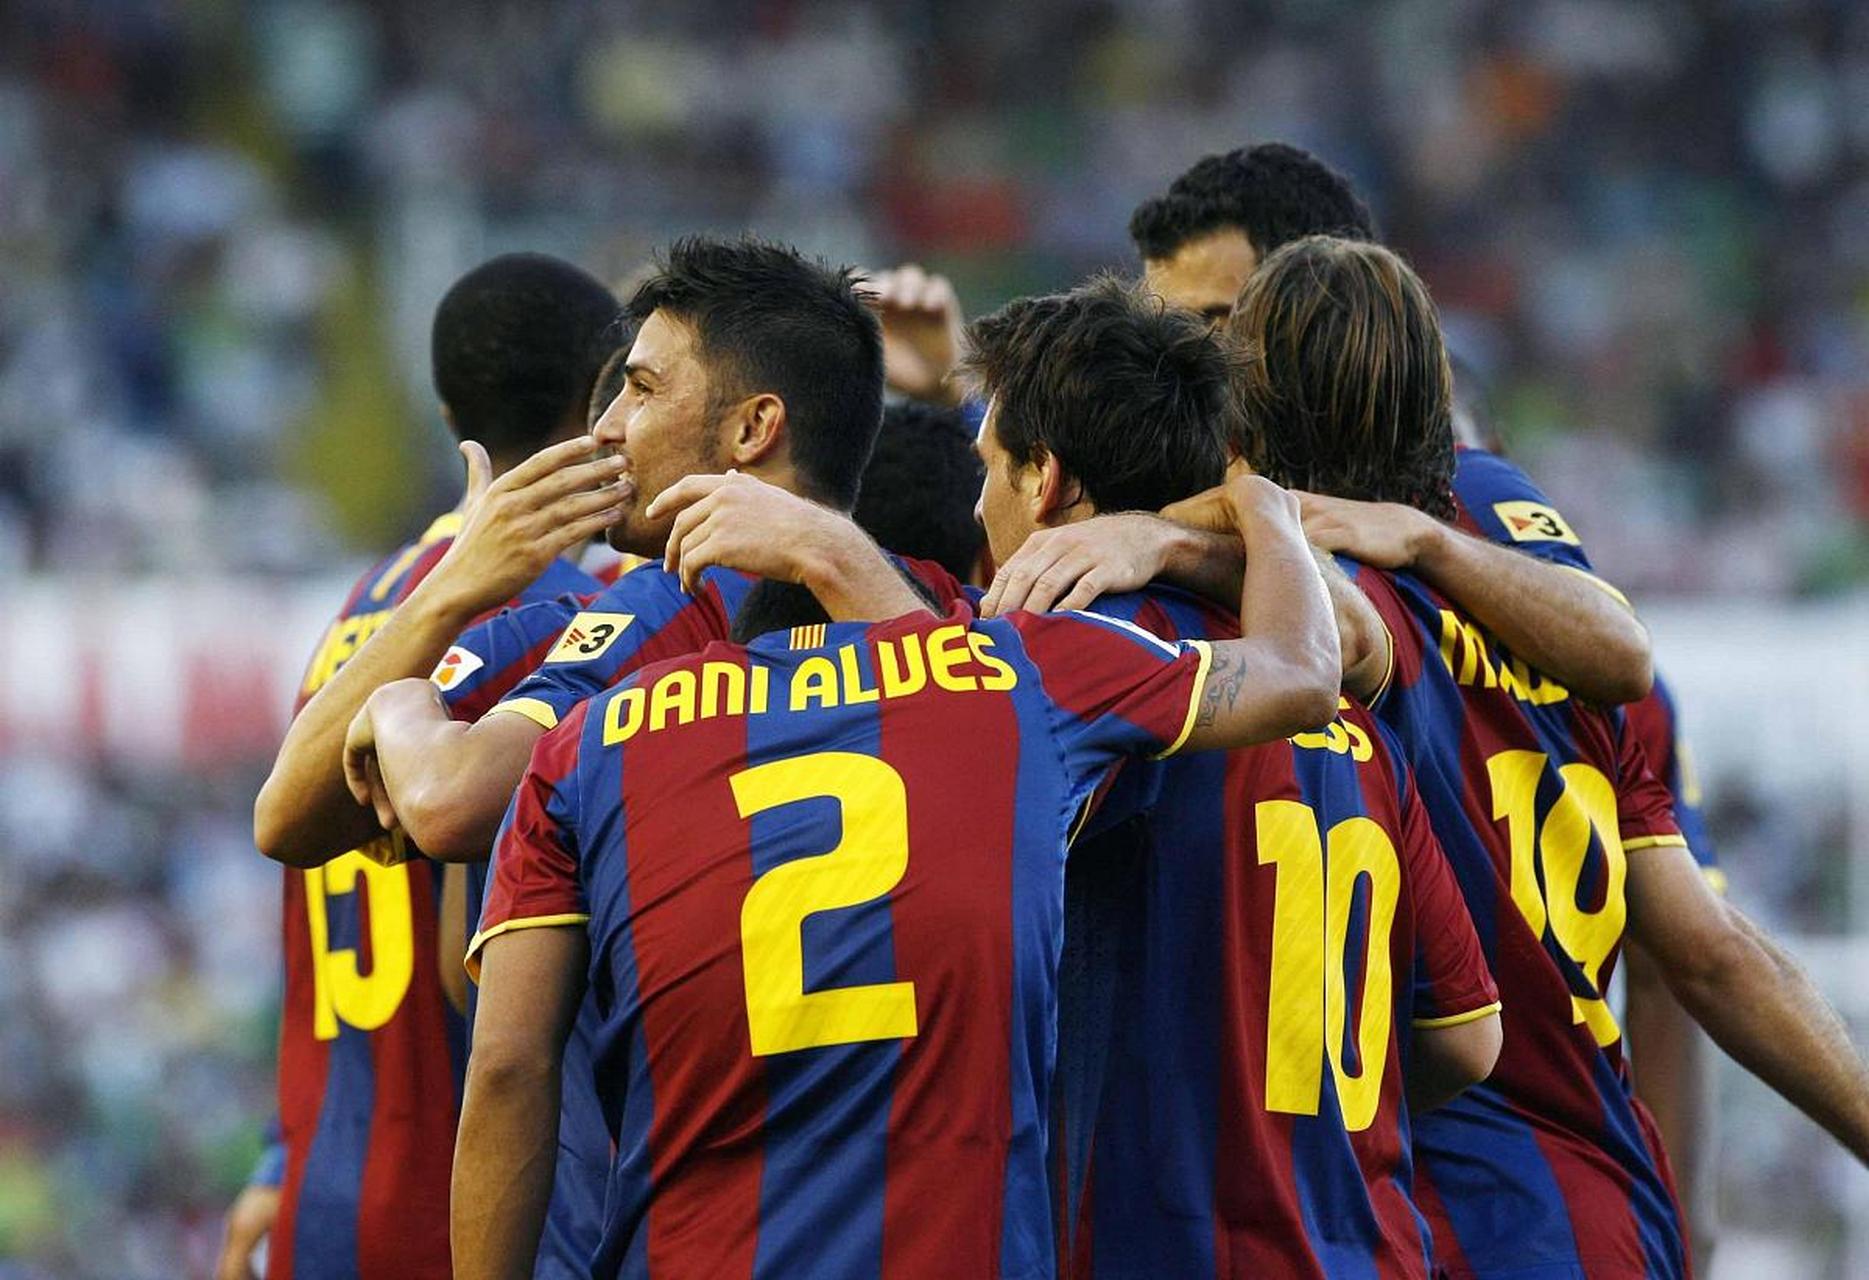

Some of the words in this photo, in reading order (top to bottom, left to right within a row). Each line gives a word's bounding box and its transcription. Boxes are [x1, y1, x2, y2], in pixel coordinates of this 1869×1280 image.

[579, 624, 615, 653] 3
[602, 661, 768, 746] DANI
[789, 624, 1018, 711] ALVES
[729, 751, 918, 1057] 2
[1254, 799, 1401, 1132] 10
[1486, 750, 1627, 1048] 19
